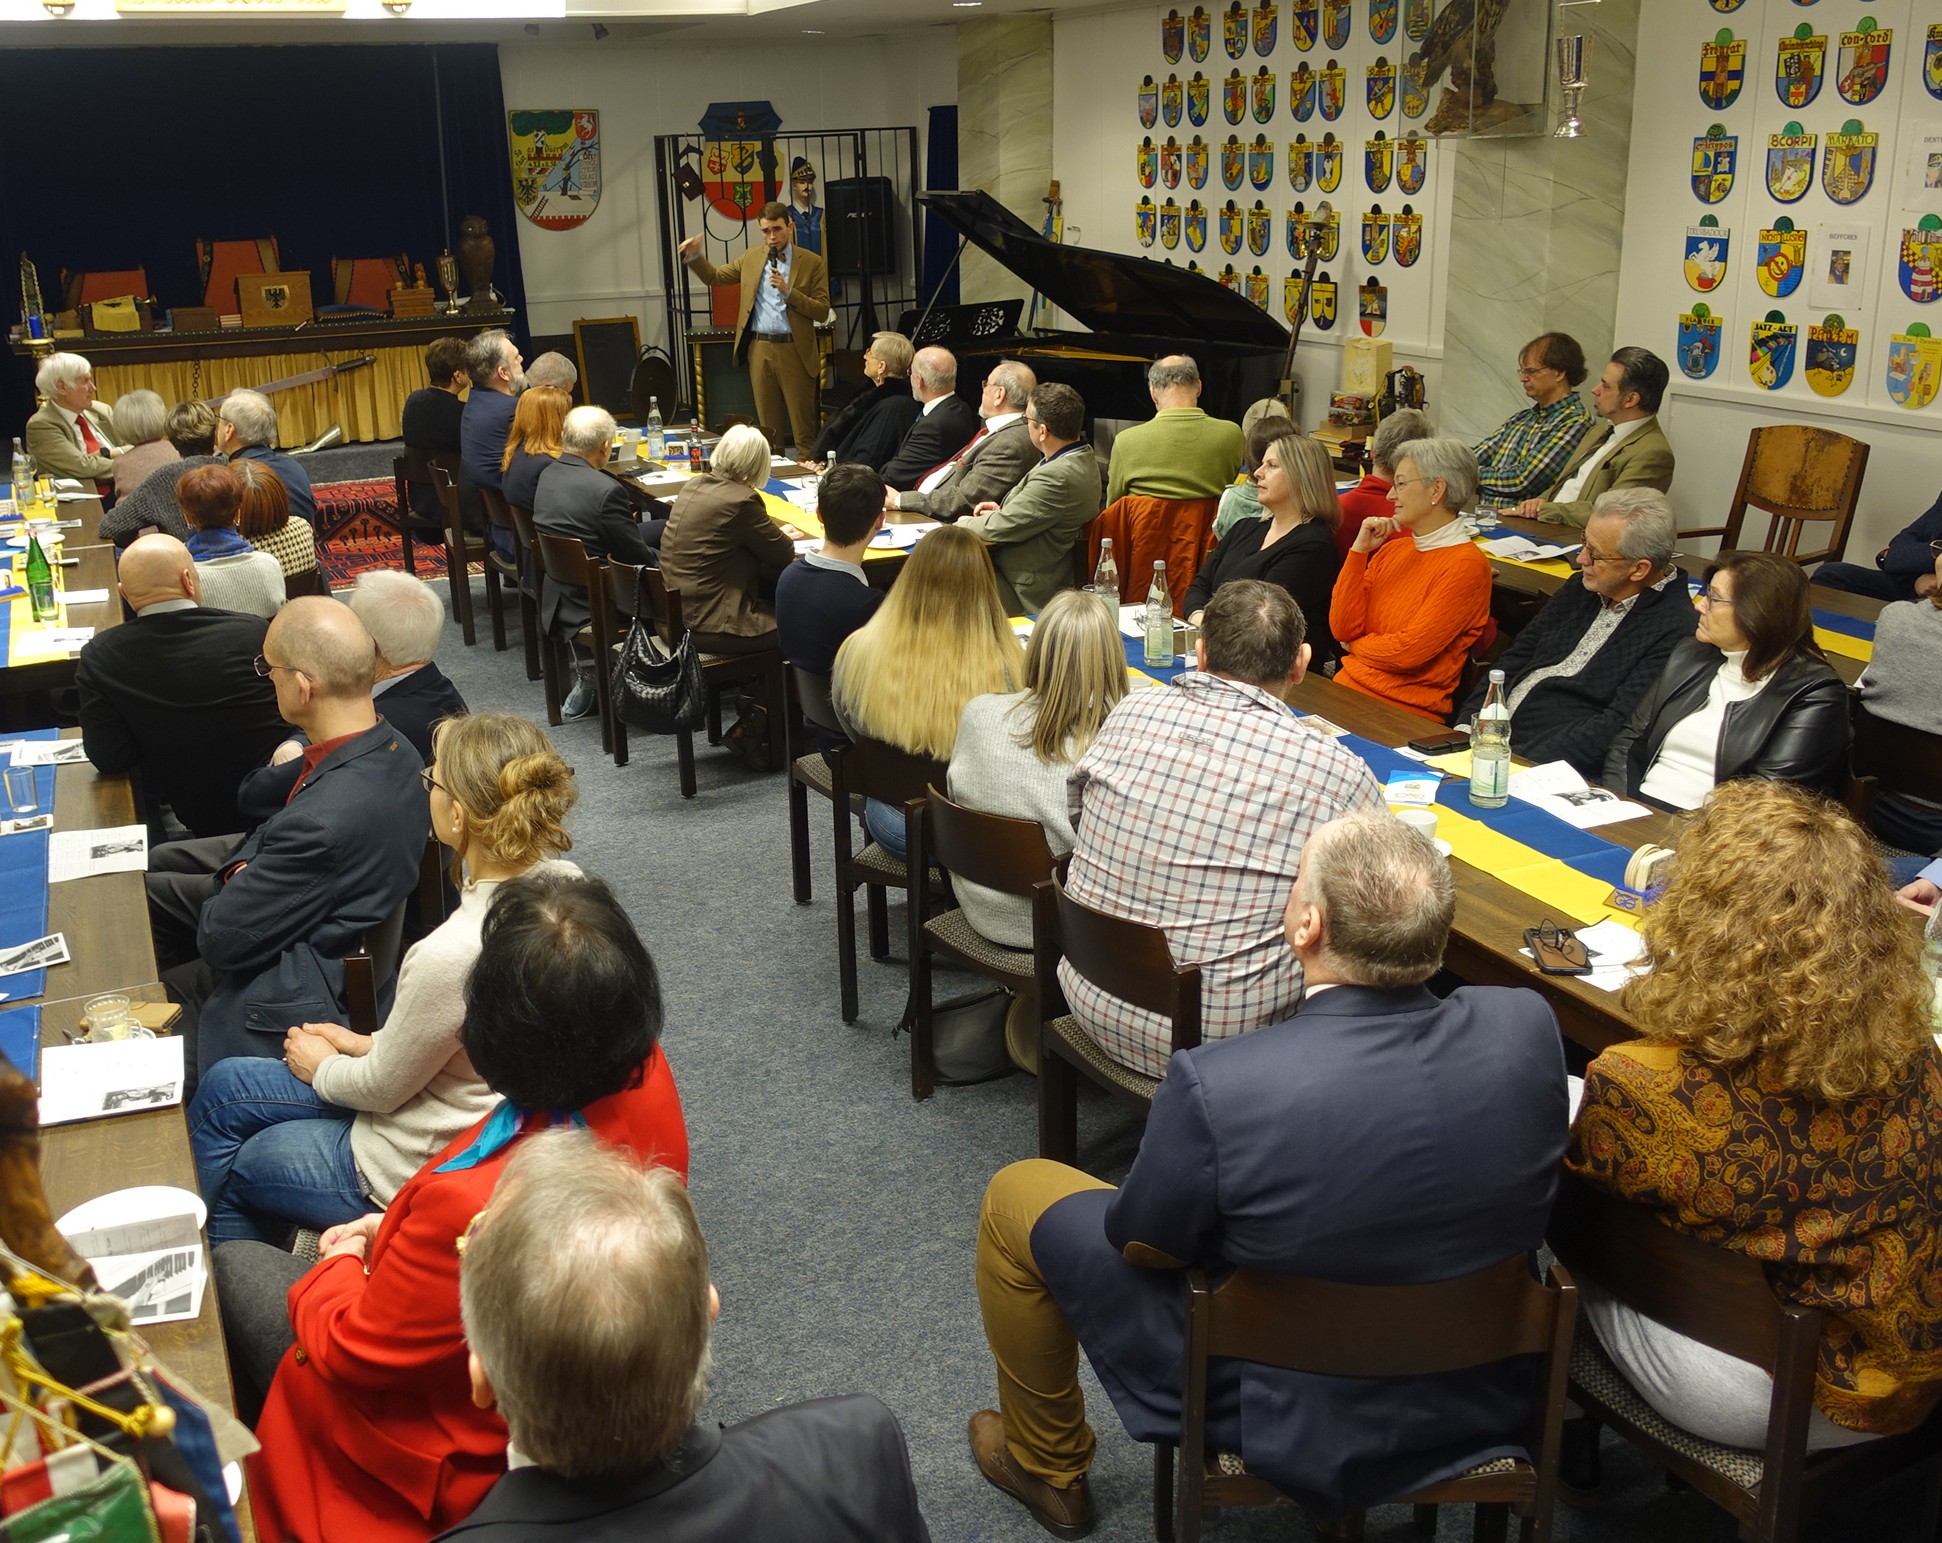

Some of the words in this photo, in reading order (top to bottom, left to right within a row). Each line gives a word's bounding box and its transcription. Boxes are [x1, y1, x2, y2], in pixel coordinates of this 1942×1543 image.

[1770, 134, 1812, 147] SCORPI
[1826, 134, 1874, 145] MARKATO
[1753, 323, 1793, 333] JATZ-ART
